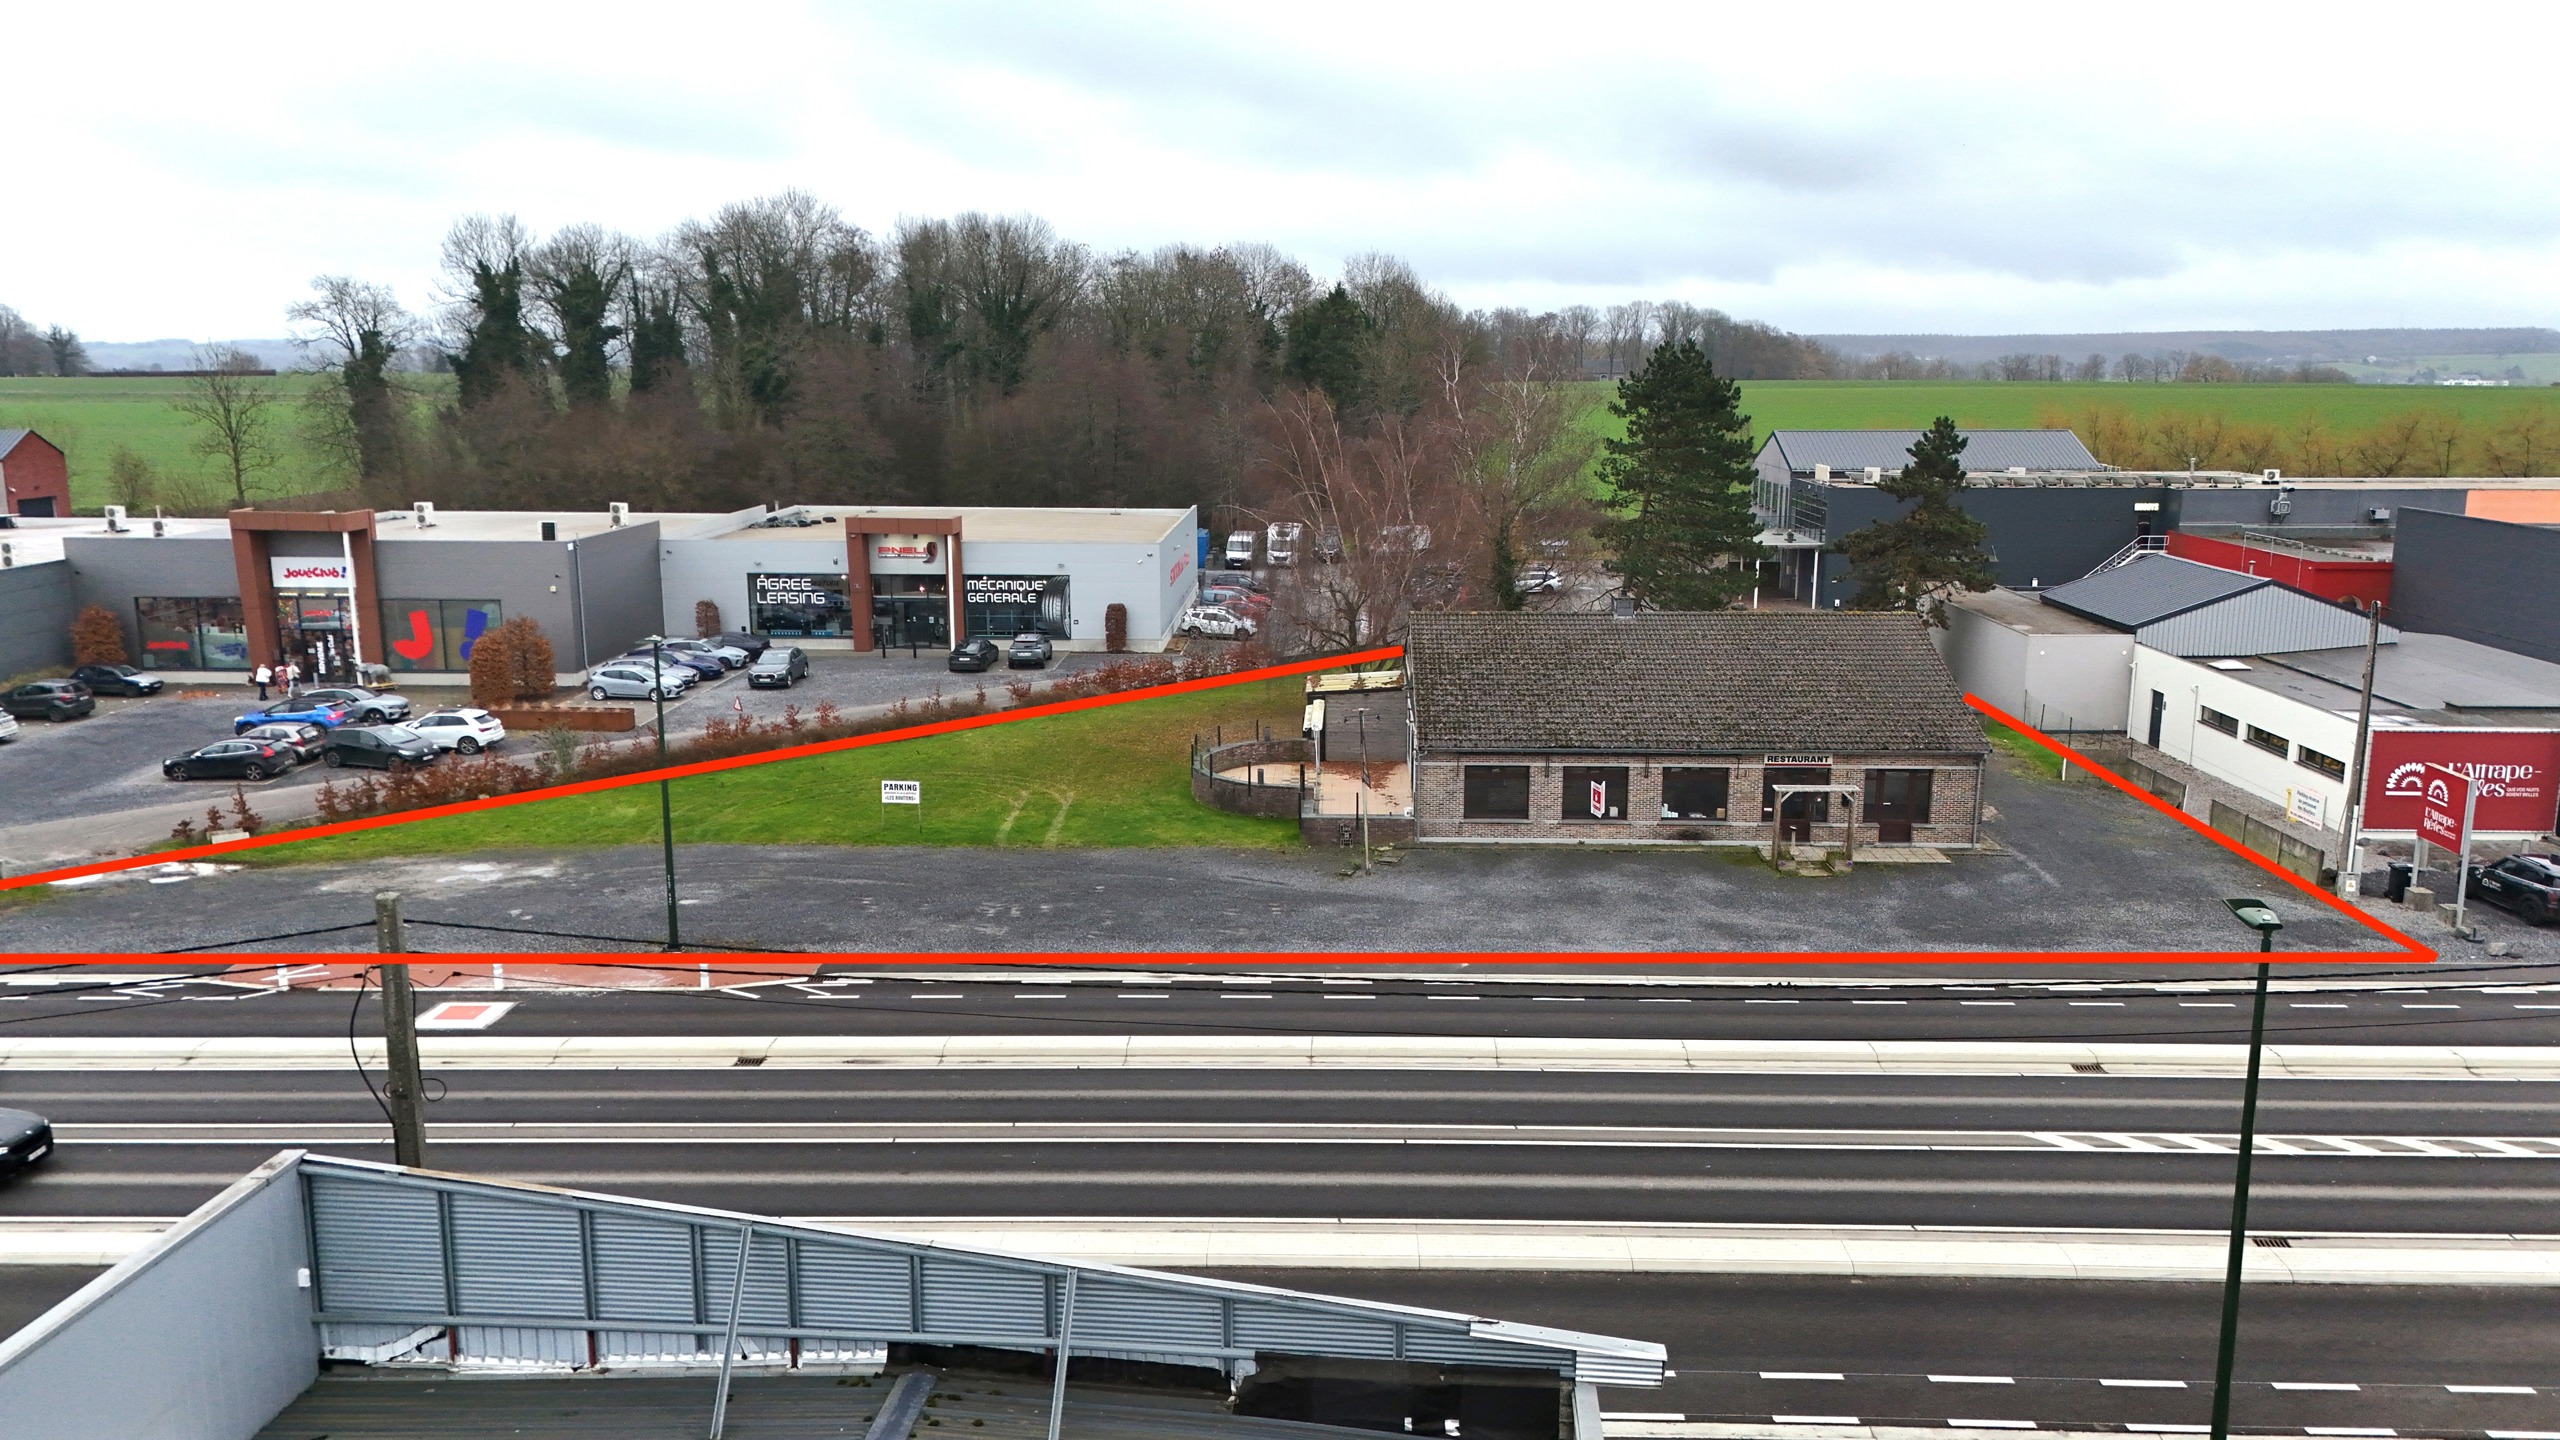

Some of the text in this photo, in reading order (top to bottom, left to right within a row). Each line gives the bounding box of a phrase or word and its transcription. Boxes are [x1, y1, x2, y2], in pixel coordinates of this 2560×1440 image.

[756, 578, 812, 590] AGREE
[756, 592, 825, 604] LEASING
[967, 593, 1036, 603] GENERALE
[1767, 755, 1830, 763] RESTAURANT
[883, 783, 918, 791] PARKING
